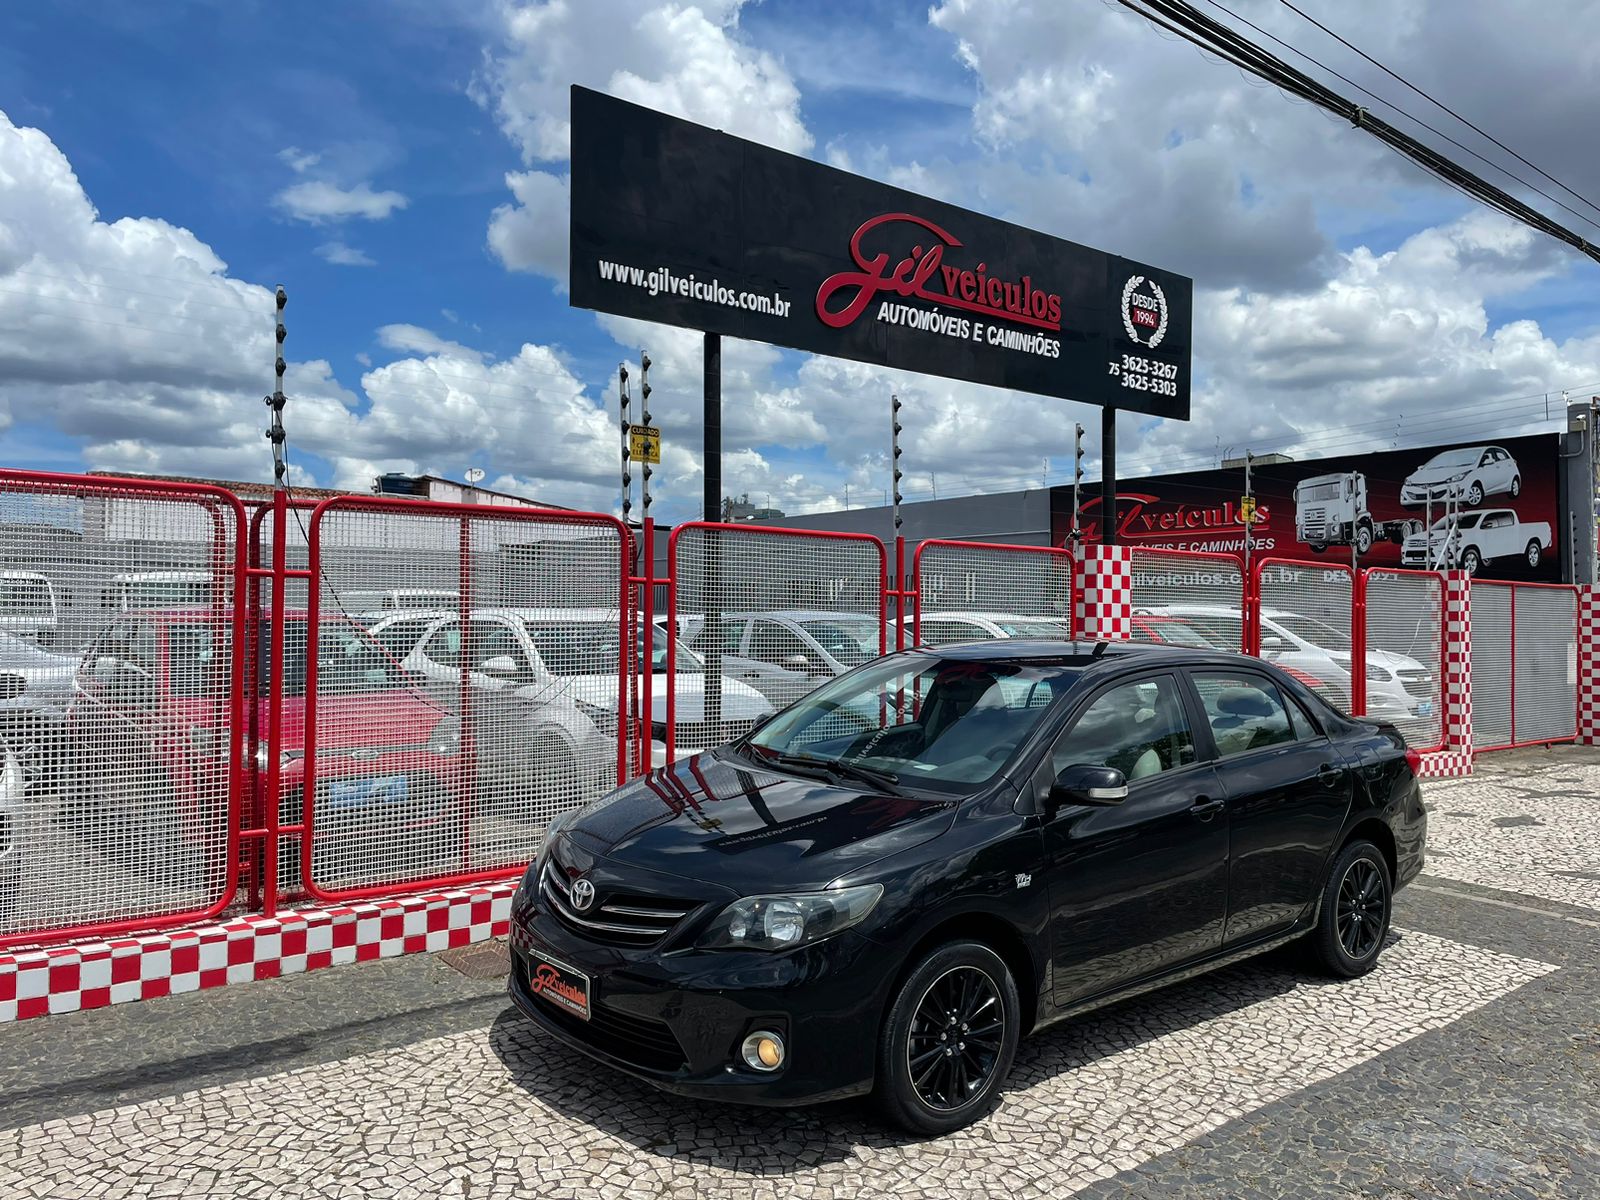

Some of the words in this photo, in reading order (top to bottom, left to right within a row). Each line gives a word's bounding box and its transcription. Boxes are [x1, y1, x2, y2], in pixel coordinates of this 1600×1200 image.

[816, 213, 963, 328] Gil
[941, 262, 1062, 323] veículos
[599, 260, 791, 317] www.gilveiculos.com.br
[1131, 292, 1158, 312] DESDE
[877, 301, 970, 339] AUTOMÓVEIS
[973, 323, 984, 342] E
[986, 325, 1061, 358] CAMINHÕES
[1136, 310, 1155, 326] 1994
[1109, 361, 1120, 376] 75
[1121, 354, 1178, 380] 3625-3267
[1121, 371, 1177, 397] 3625-5303
